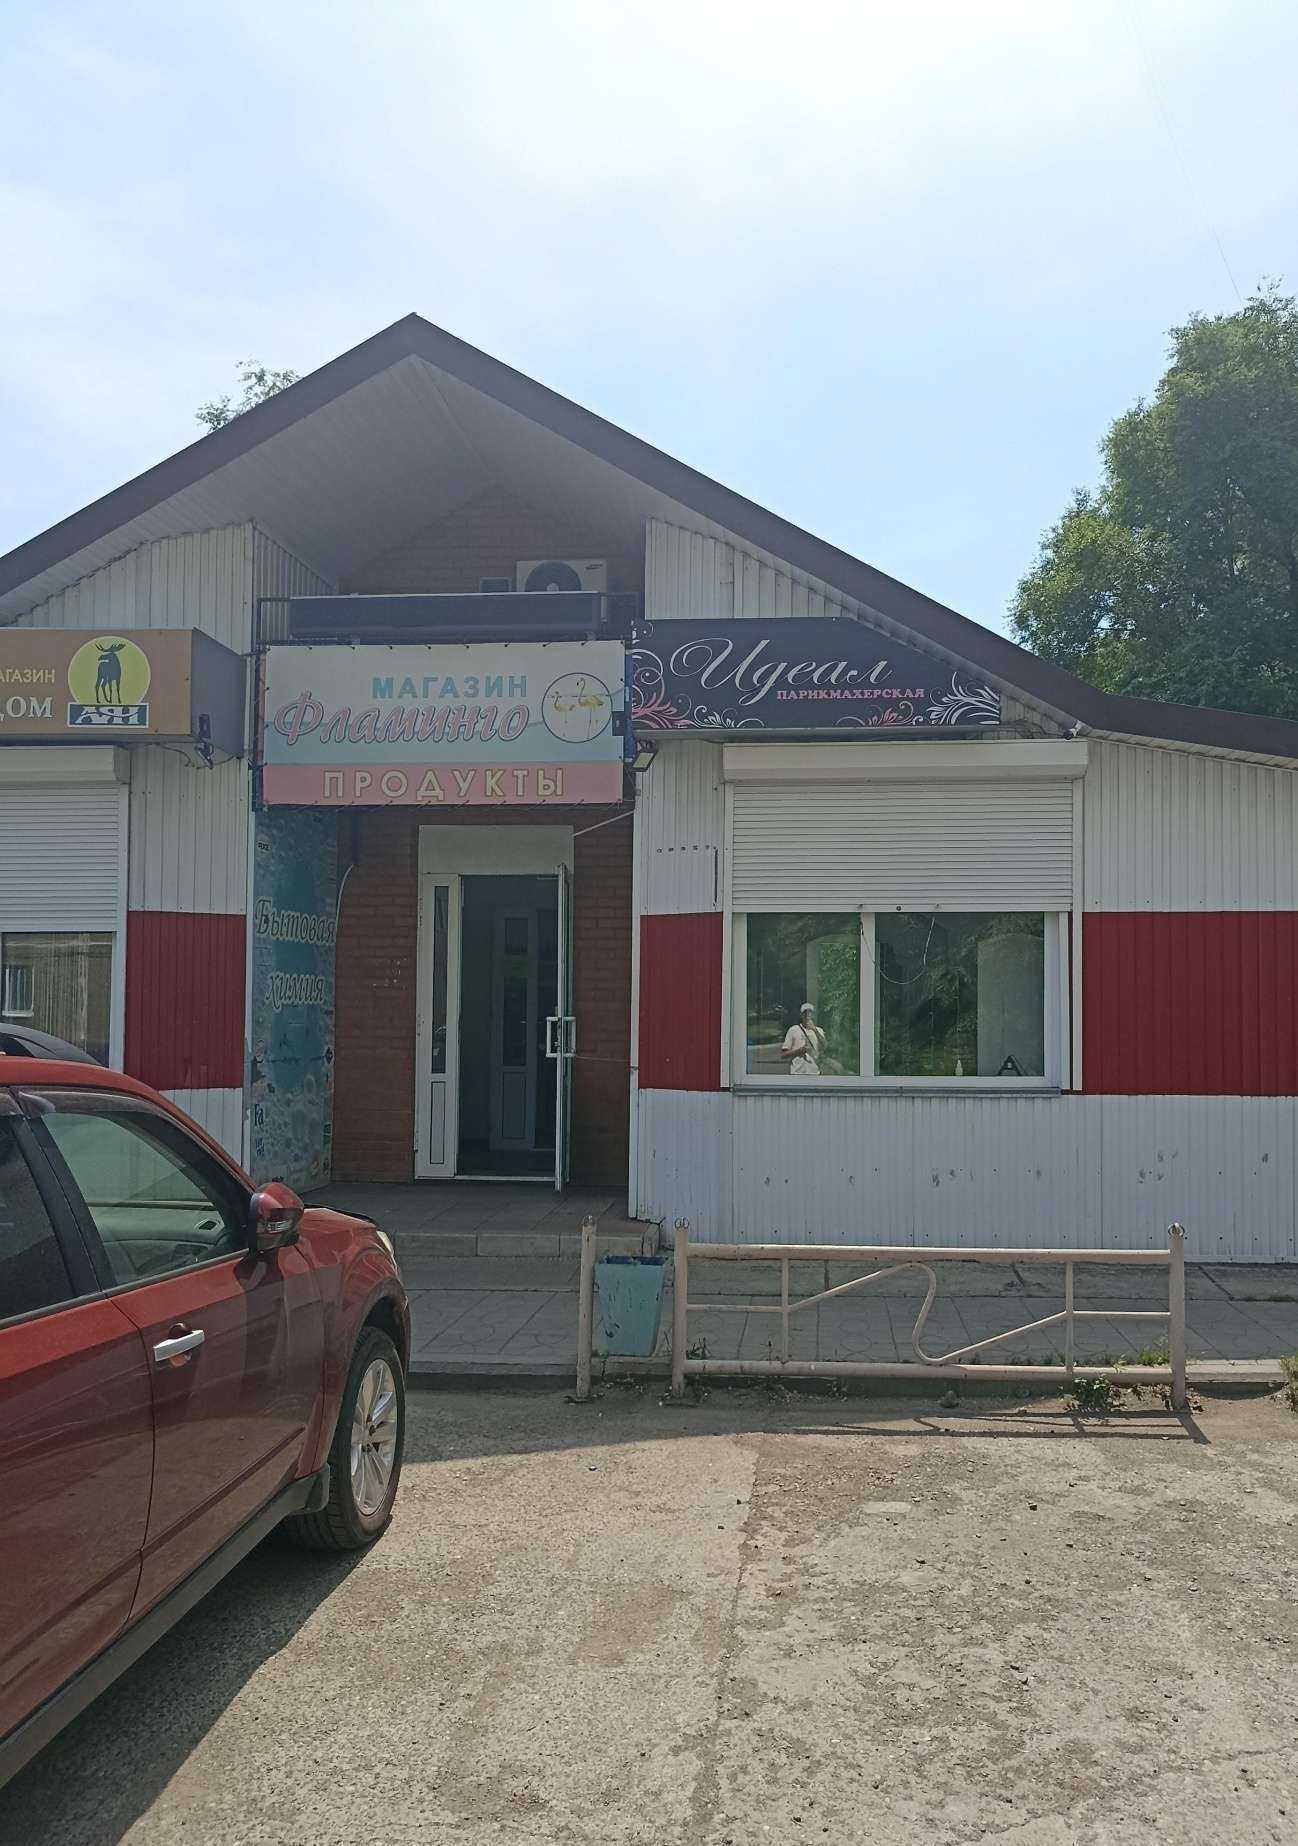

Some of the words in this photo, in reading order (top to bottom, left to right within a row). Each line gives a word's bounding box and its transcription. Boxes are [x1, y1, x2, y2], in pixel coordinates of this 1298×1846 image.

[372, 675, 528, 698] МАГАЗИН
[669, 637, 893, 706] Идеал
[0, 696, 53, 721] ОМ
[775, 688, 925, 701] ПАРИКМАХЕРСКАЯ
[273, 688, 530, 746] Фламинго
[322, 767, 564, 801] ПРОДУКТЫ
[255, 896, 337, 945] Бытовая
[264, 969, 326, 1013] химия
